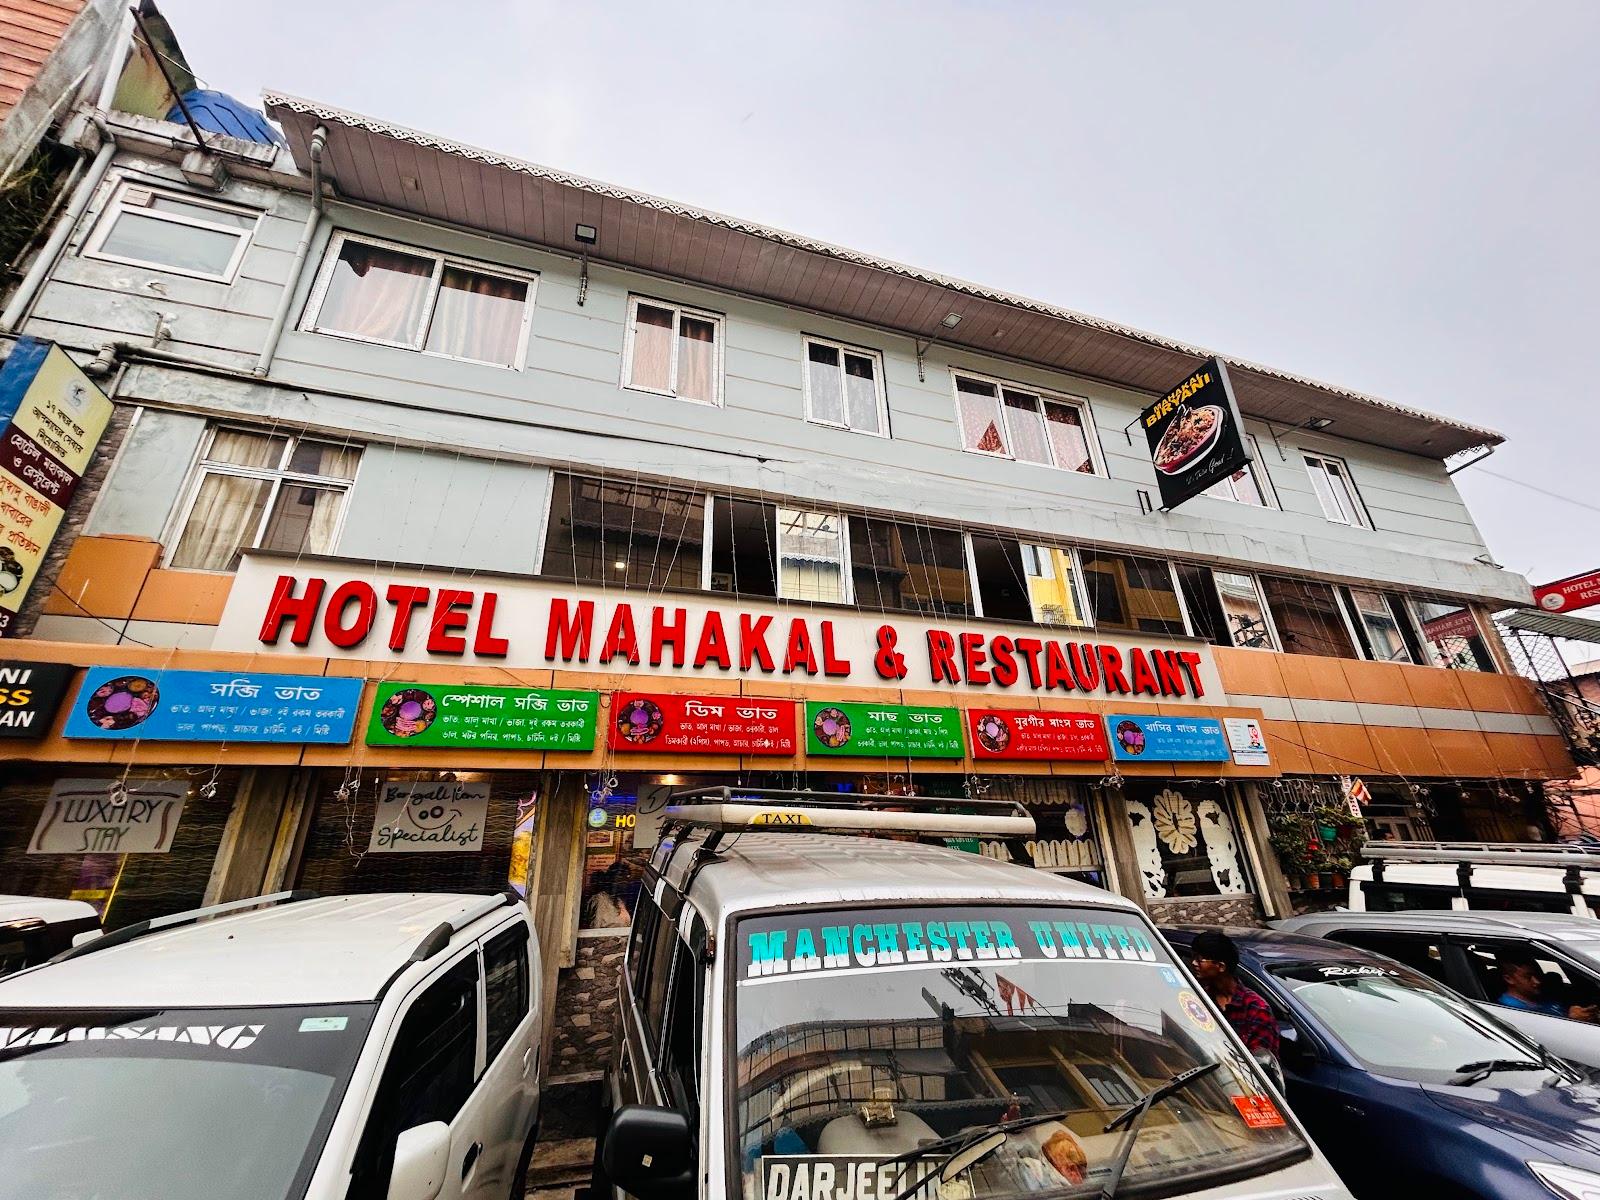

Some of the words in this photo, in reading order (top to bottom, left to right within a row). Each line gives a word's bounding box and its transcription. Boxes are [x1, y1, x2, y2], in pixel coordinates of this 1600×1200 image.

[1146, 373, 1211, 427] BIRYANI
[10, 434, 42, 461] হোটেল
[43, 457, 74, 486] মহাকাল
[13, 456, 22, 467] ও
[1562, 580, 1597, 594] HOTEL
[259, 575, 510, 659] HOTEL
[545, 598, 851, 678] MAHAKAL
[874, 624, 907, 680] &
[927, 629, 1205, 698] RESTAURANT
[274, 686, 323, 700] ভাত
[442, 693, 506, 709] স্পেশাল
[557, 699, 590, 712] ভাত
[685, 700, 725, 717] ডিম
[736, 707, 778, 719] ভাত
[867, 711, 899, 722] মাছ
[907, 713, 942, 724] ভাত
[1049, 718, 1071, 728] মাংস
[1075, 719, 1094, 729] ভাত
[1145, 721, 1172, 733] খাসির
[1176, 723, 1198, 734] মাংস
[1201, 726, 1220, 735] ভাত
[762, 813, 802, 825] TAXI
[77, 827, 130, 851] STAY
[747, 920, 1021, 977] MANCHESTER
[1029, 920, 1157, 962] UNITED
